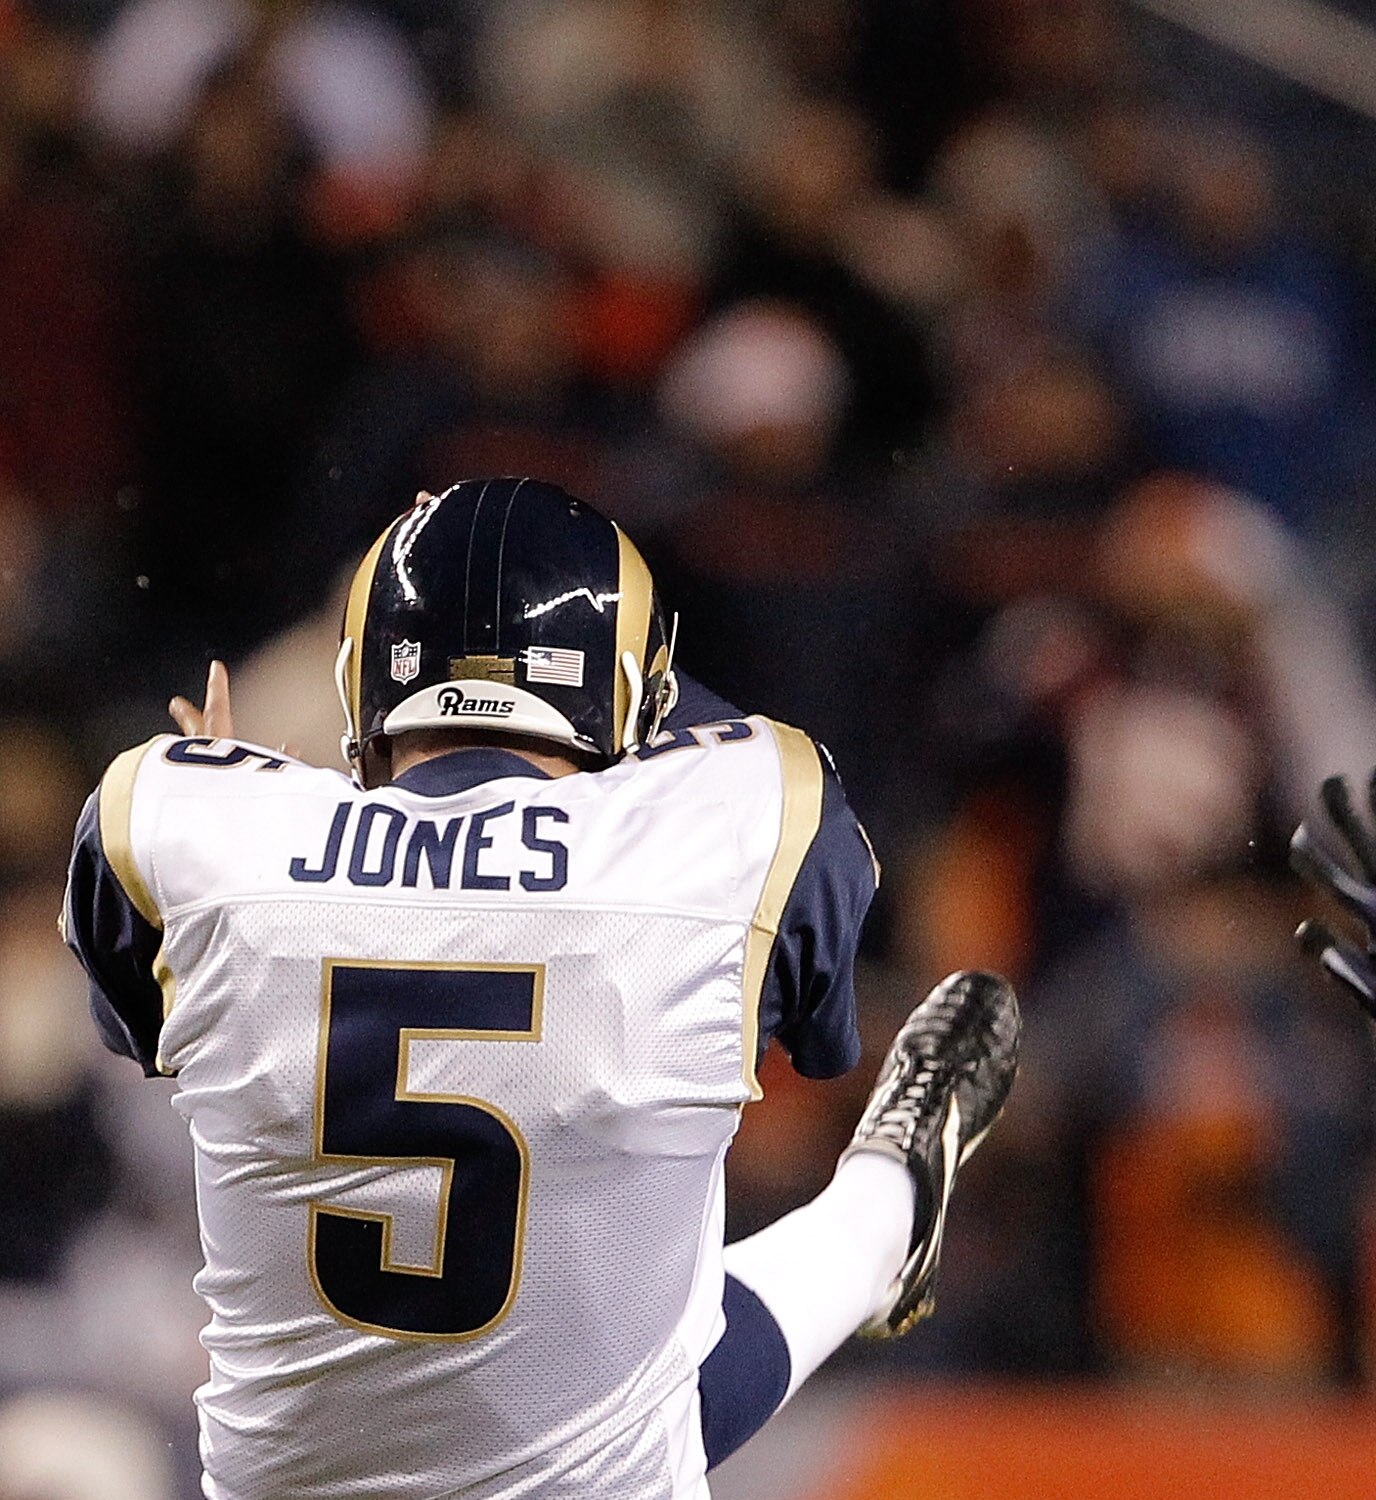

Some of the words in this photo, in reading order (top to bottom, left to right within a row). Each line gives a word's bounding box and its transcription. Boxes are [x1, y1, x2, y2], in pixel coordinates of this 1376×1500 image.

[437, 687, 516, 718] Rams
[289, 801, 569, 893] JONES
[306, 957, 546, 1345] 5
